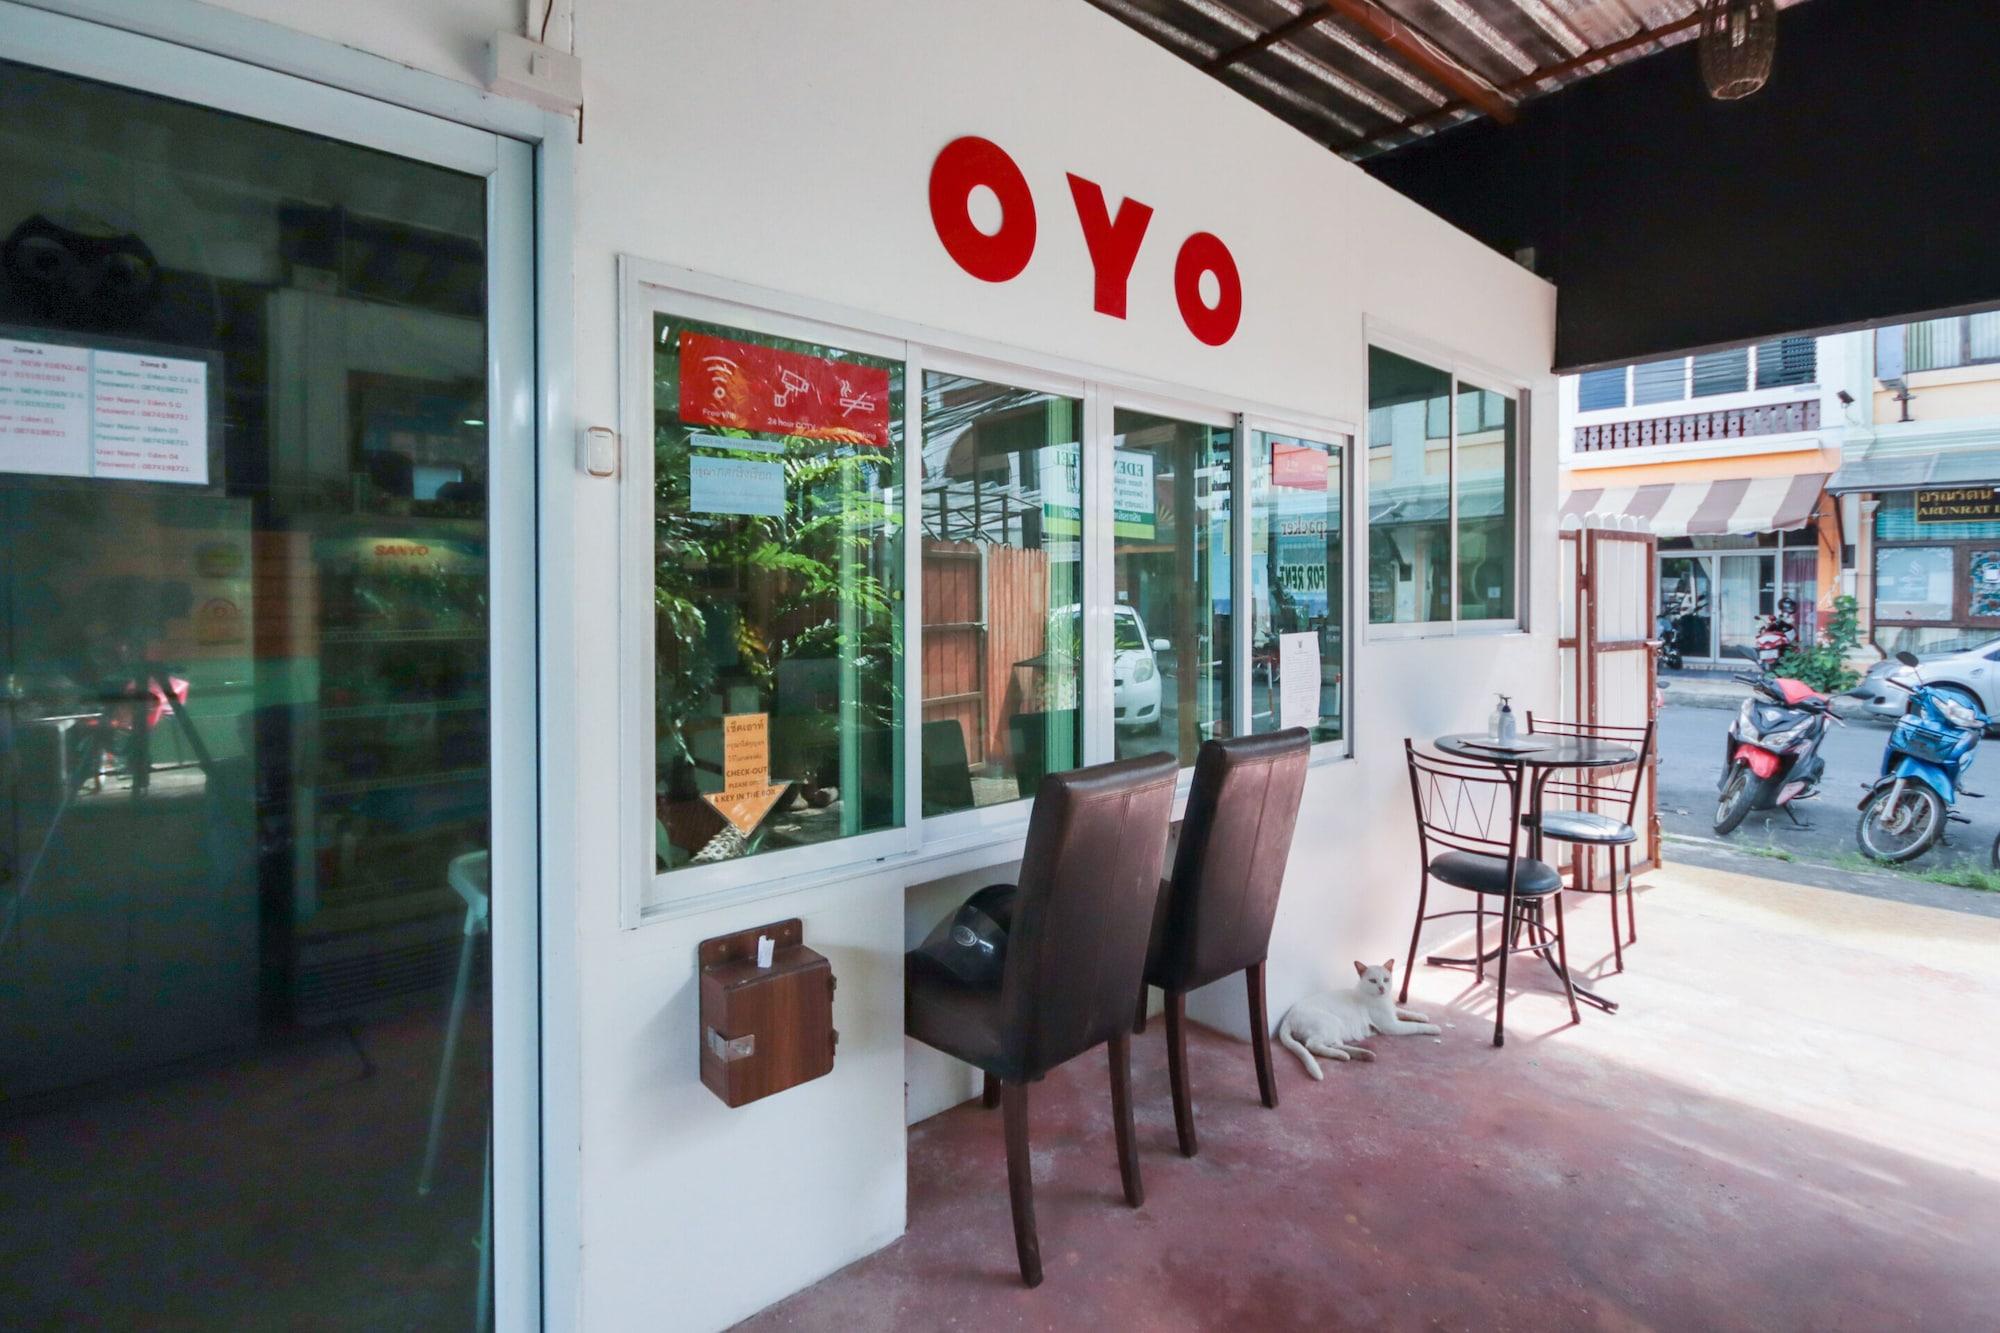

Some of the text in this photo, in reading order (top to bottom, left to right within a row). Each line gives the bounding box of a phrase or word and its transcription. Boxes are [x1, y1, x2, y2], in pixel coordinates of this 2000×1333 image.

[929, 136, 1242, 346] OYO
[702, 408, 721, 418] Free
[778, 417, 794, 428] hour
[795, 420, 817, 431] CCTV
[1918, 504, 1991, 516] ARUNRAT
[374, 545, 429, 556] SANYO
[726, 766, 768, 778] CHECK-OUT
[728, 781, 748, 789] PLEASE
[720, 794, 734, 803] KEY
